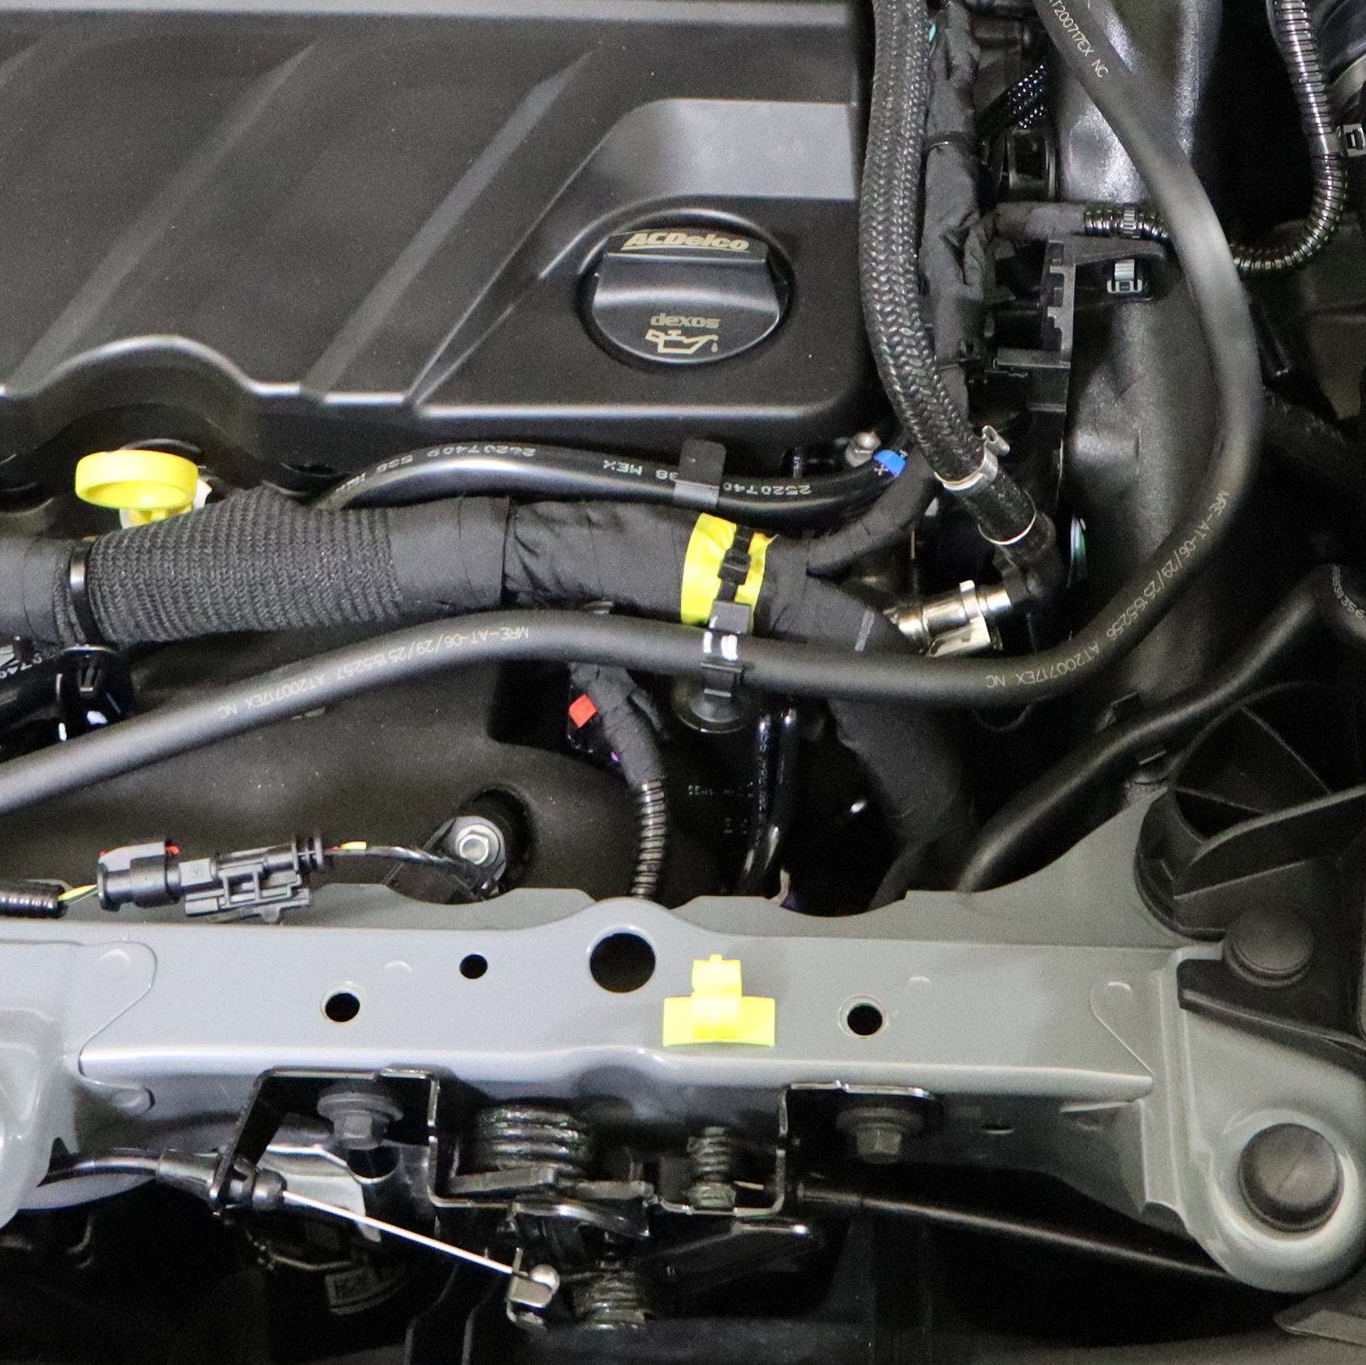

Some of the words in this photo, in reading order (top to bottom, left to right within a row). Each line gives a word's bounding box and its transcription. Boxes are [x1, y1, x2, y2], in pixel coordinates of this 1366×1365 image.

[1091, 58, 1110, 79] NC
[623, 232, 750, 253] ACDelco
[650, 312, 722, 329] dexos
[602, 459, 643, 476] MEX
[723, 481, 812, 496] 2520740
[1015, 641, 1101, 686] AT200717EX
[984, 673, 1007, 689] NC
[244, 672, 325, 709] AT200717EX
[216, 703, 238, 719] NC
